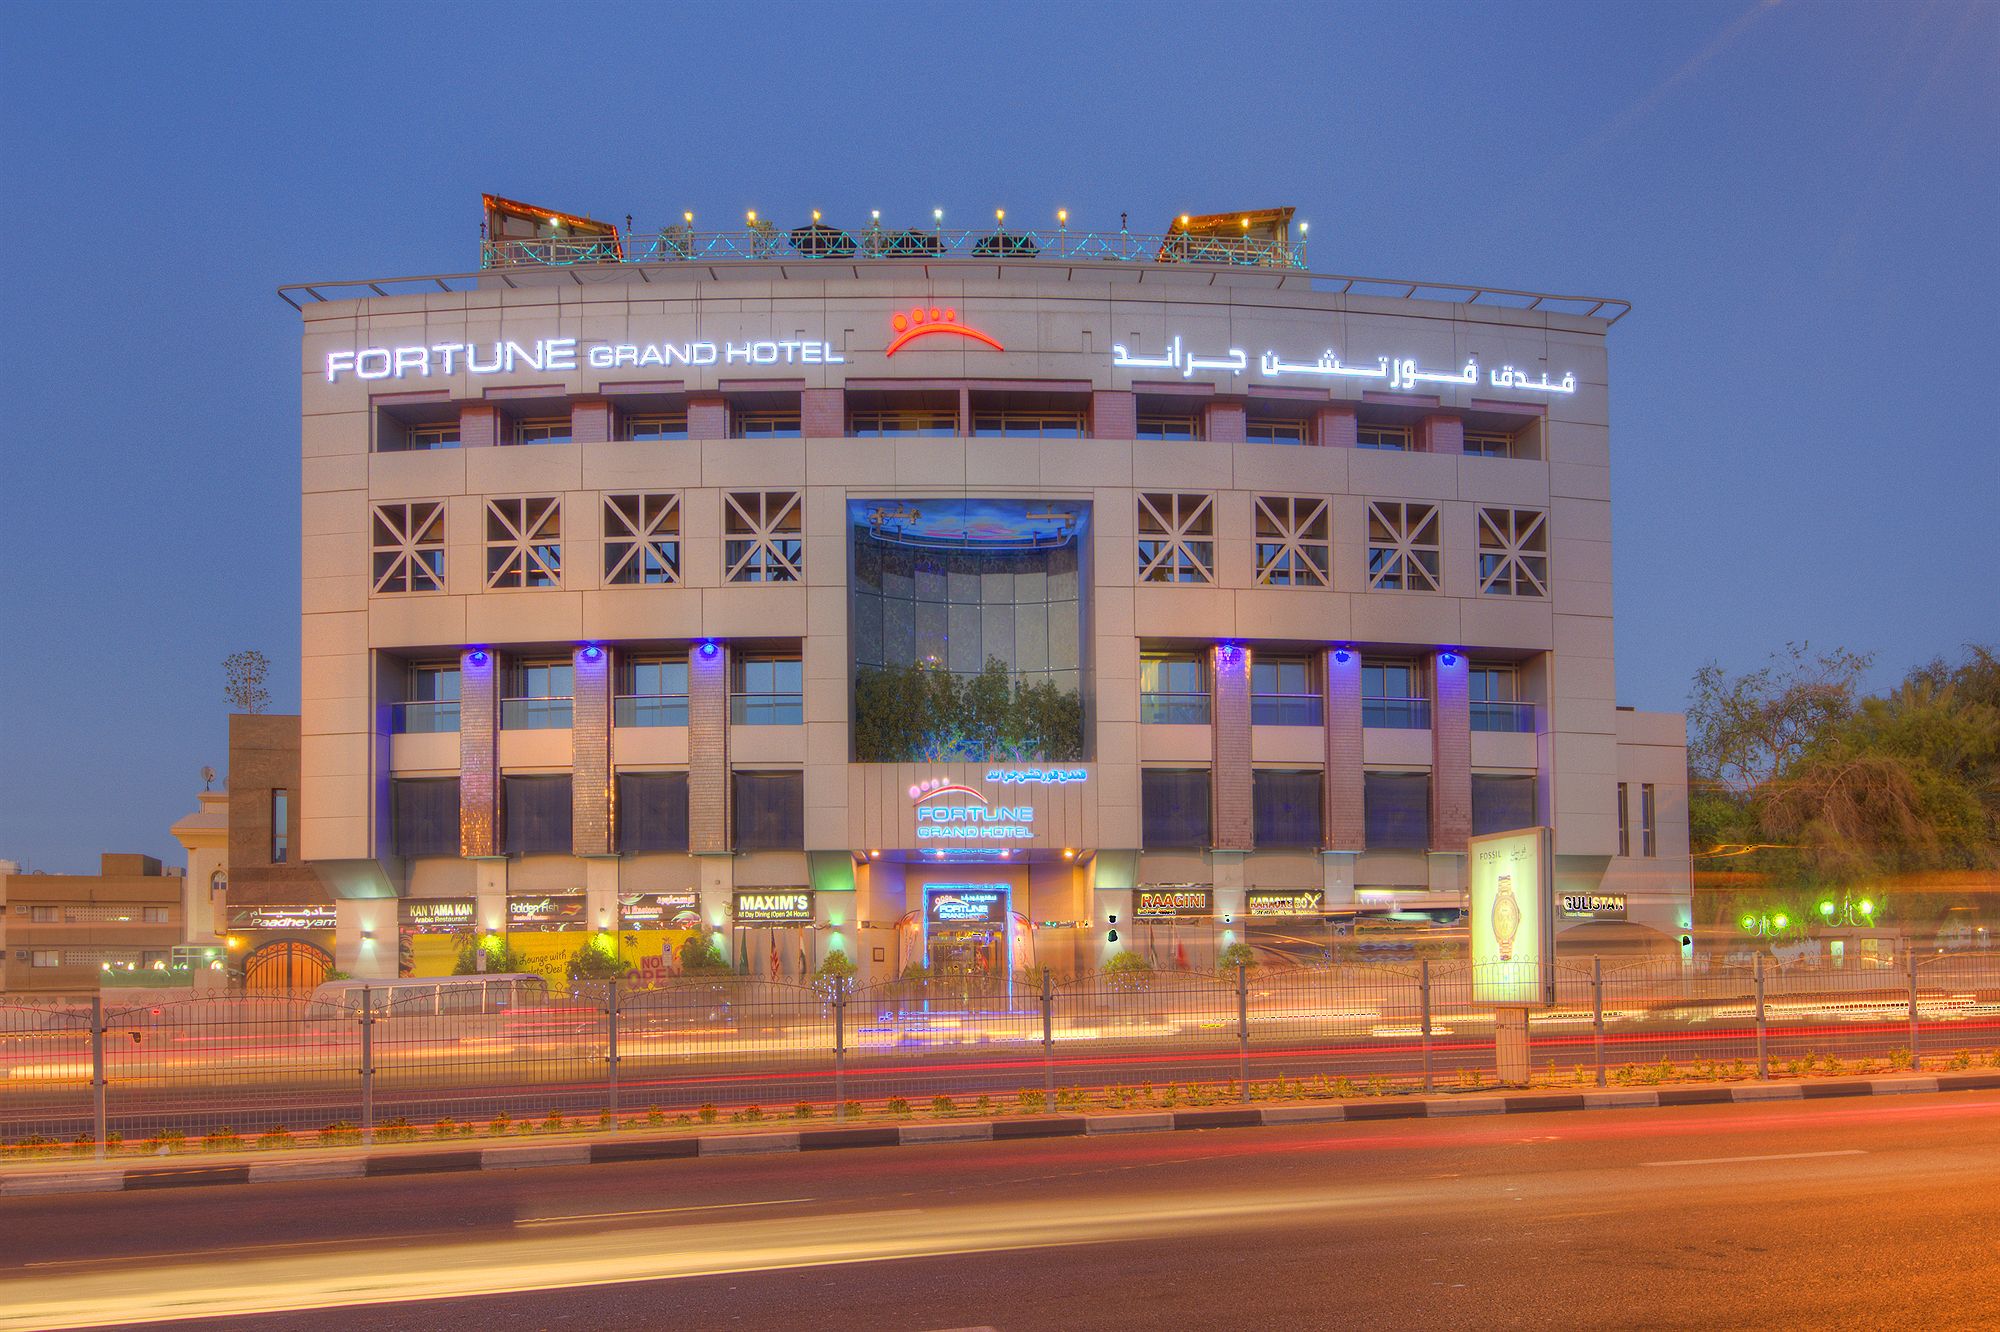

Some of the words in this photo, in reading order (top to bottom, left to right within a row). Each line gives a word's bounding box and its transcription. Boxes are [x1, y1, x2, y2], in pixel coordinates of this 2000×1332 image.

[327, 338, 577, 384] FORTUNE
[589, 343, 718, 369] GRAND
[727, 341, 845, 365] HOTEL
[1113, 336, 1247, 378] جراند
[917, 806, 1034, 822] FORTUNE
[917, 827, 979, 838] GRAND
[981, 826, 1034, 838] HOTEL
[1479, 849, 1501, 860] FOSSIL
[740, 895, 808, 910] MAXIM'S
[1141, 893, 1206, 908] RAAGINI
[1249, 896, 1293, 909] KARAOKE
[1563, 895, 1624, 910] GULISTAN
[410, 905, 427, 916] KAN
[429, 904, 454, 916] YAMA
[455, 904, 473, 915] KAN
[510, 903, 539, 913] Golden
[939, 904, 988, 913] FORTUNE
[251, 918, 337, 929] Paadheyam
[519, 953, 548, 966] Lounge
[549, 949, 567, 961] with
[642, 956, 667, 969] NO
[545, 963, 563, 974] Desi
